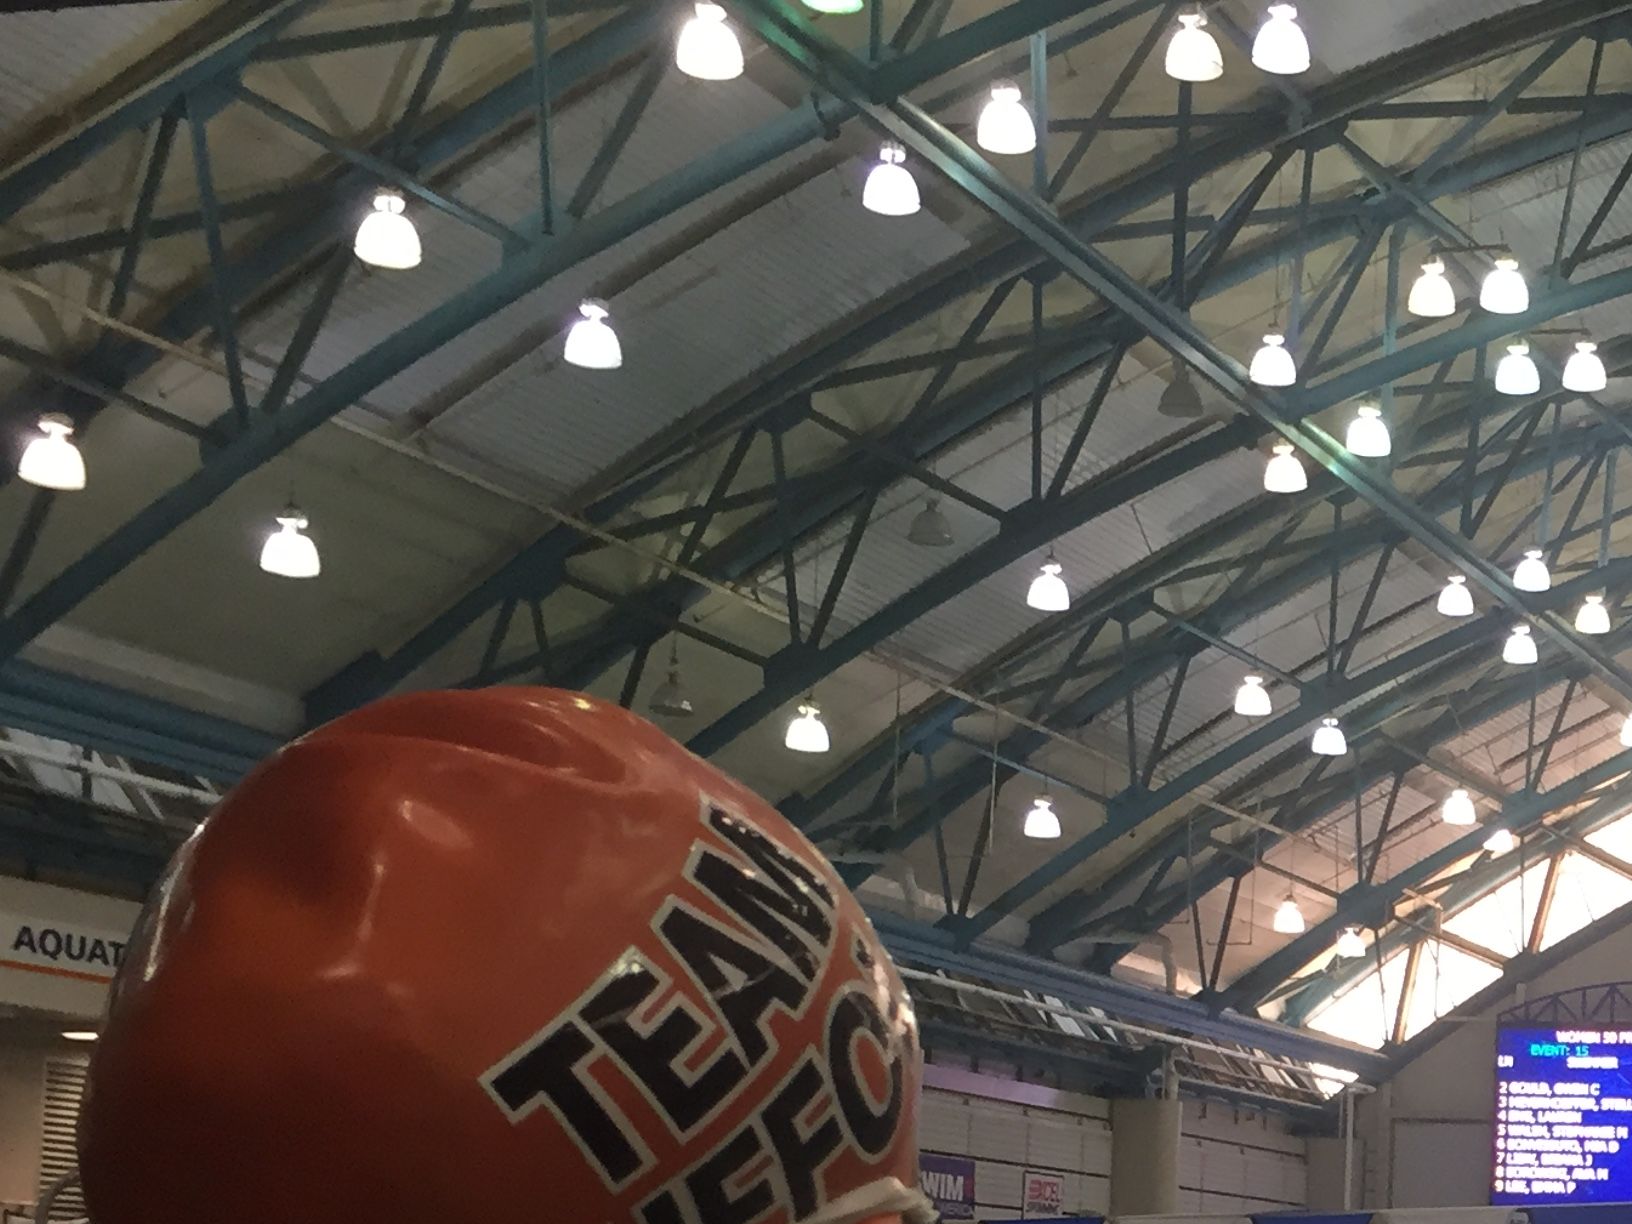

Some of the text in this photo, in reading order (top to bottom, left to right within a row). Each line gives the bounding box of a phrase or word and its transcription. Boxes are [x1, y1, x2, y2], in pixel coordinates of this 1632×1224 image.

[477, 790, 838, 1196] TEAM
[1557, 1031, 1600, 1043] WOMEN
[1531, 1044, 1588, 1056] EVENT: 15
[1499, 1081, 1507, 1094] 2
[1591, 1083, 1600, 1095] C
[1499, 1096, 1507, 1109] 3
[1497, 1111, 1506, 1122] 4
[1498, 1125, 1506, 1136] 5
[1497, 1138, 1505, 1150] 6
[1497, 1152, 1505, 1163] 7
[1496, 1167, 1504, 1178] 8
[1495, 1181, 1504, 1192] 9
